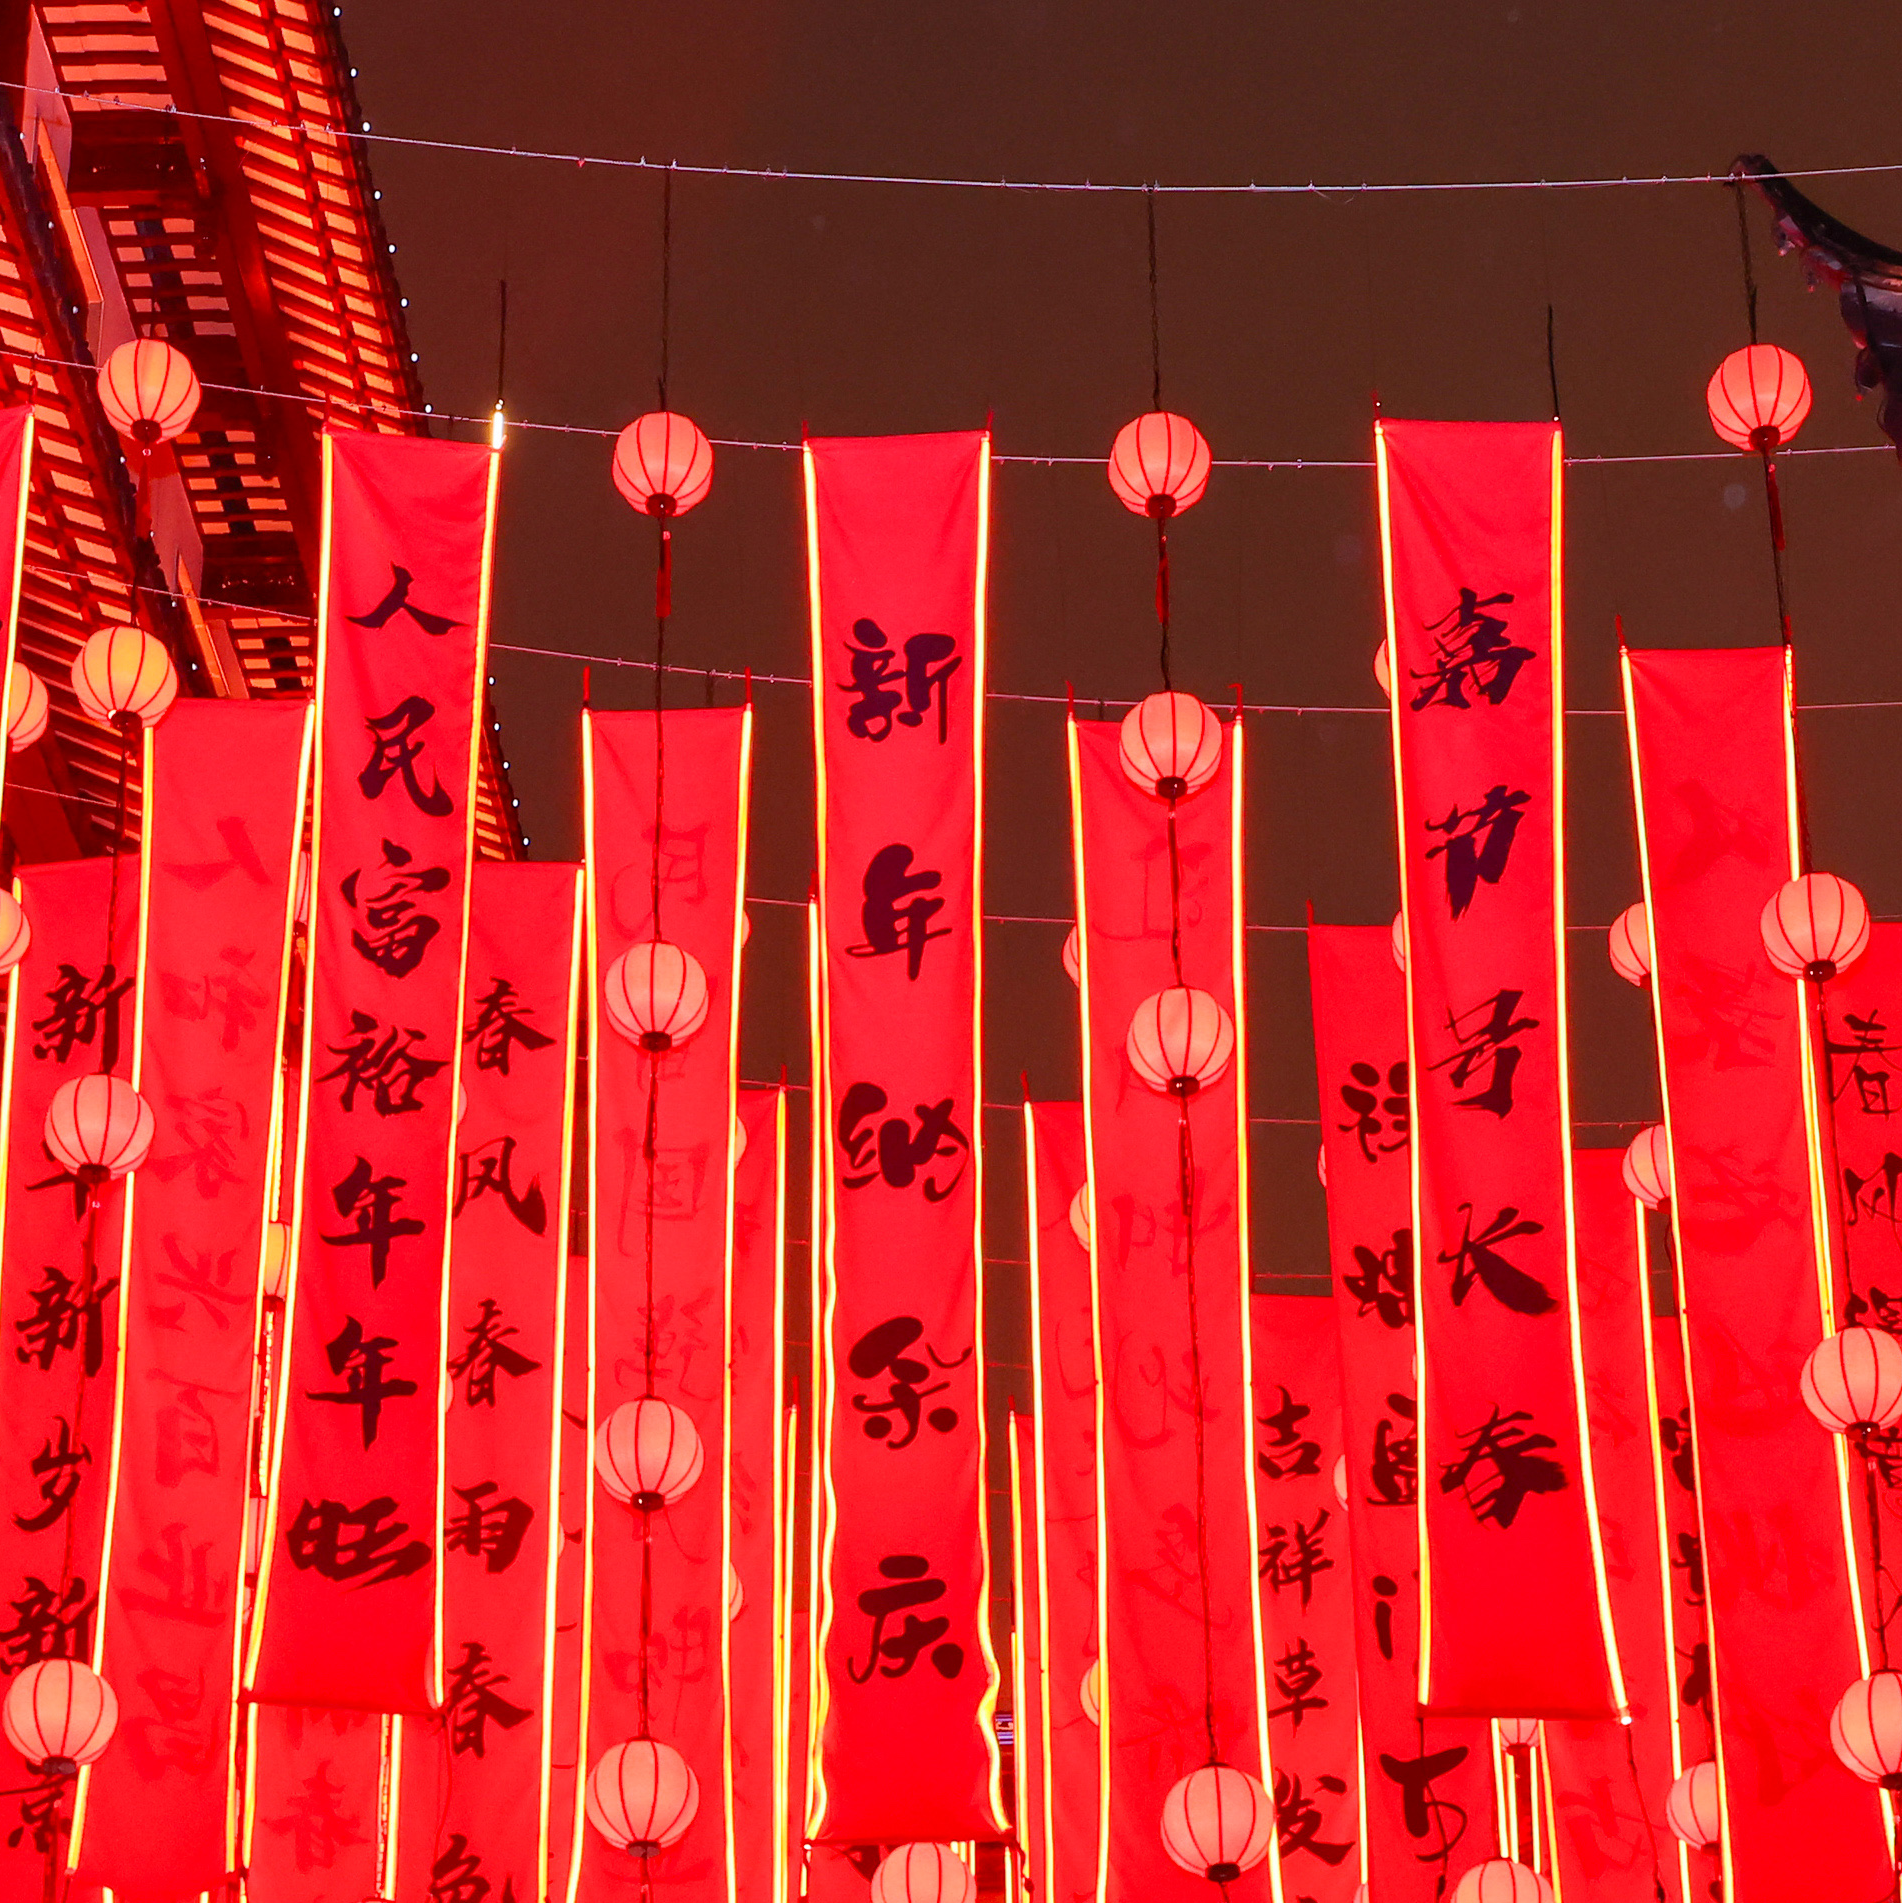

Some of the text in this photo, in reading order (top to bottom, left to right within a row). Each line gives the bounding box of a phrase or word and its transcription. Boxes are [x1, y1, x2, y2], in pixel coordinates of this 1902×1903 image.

[287, 566, 467, 1588] 人民富裕年年旺
[836, 618, 974, 1683] 新年纳余庆
[1411, 587, 1569, 1530] 嘉节号长春
